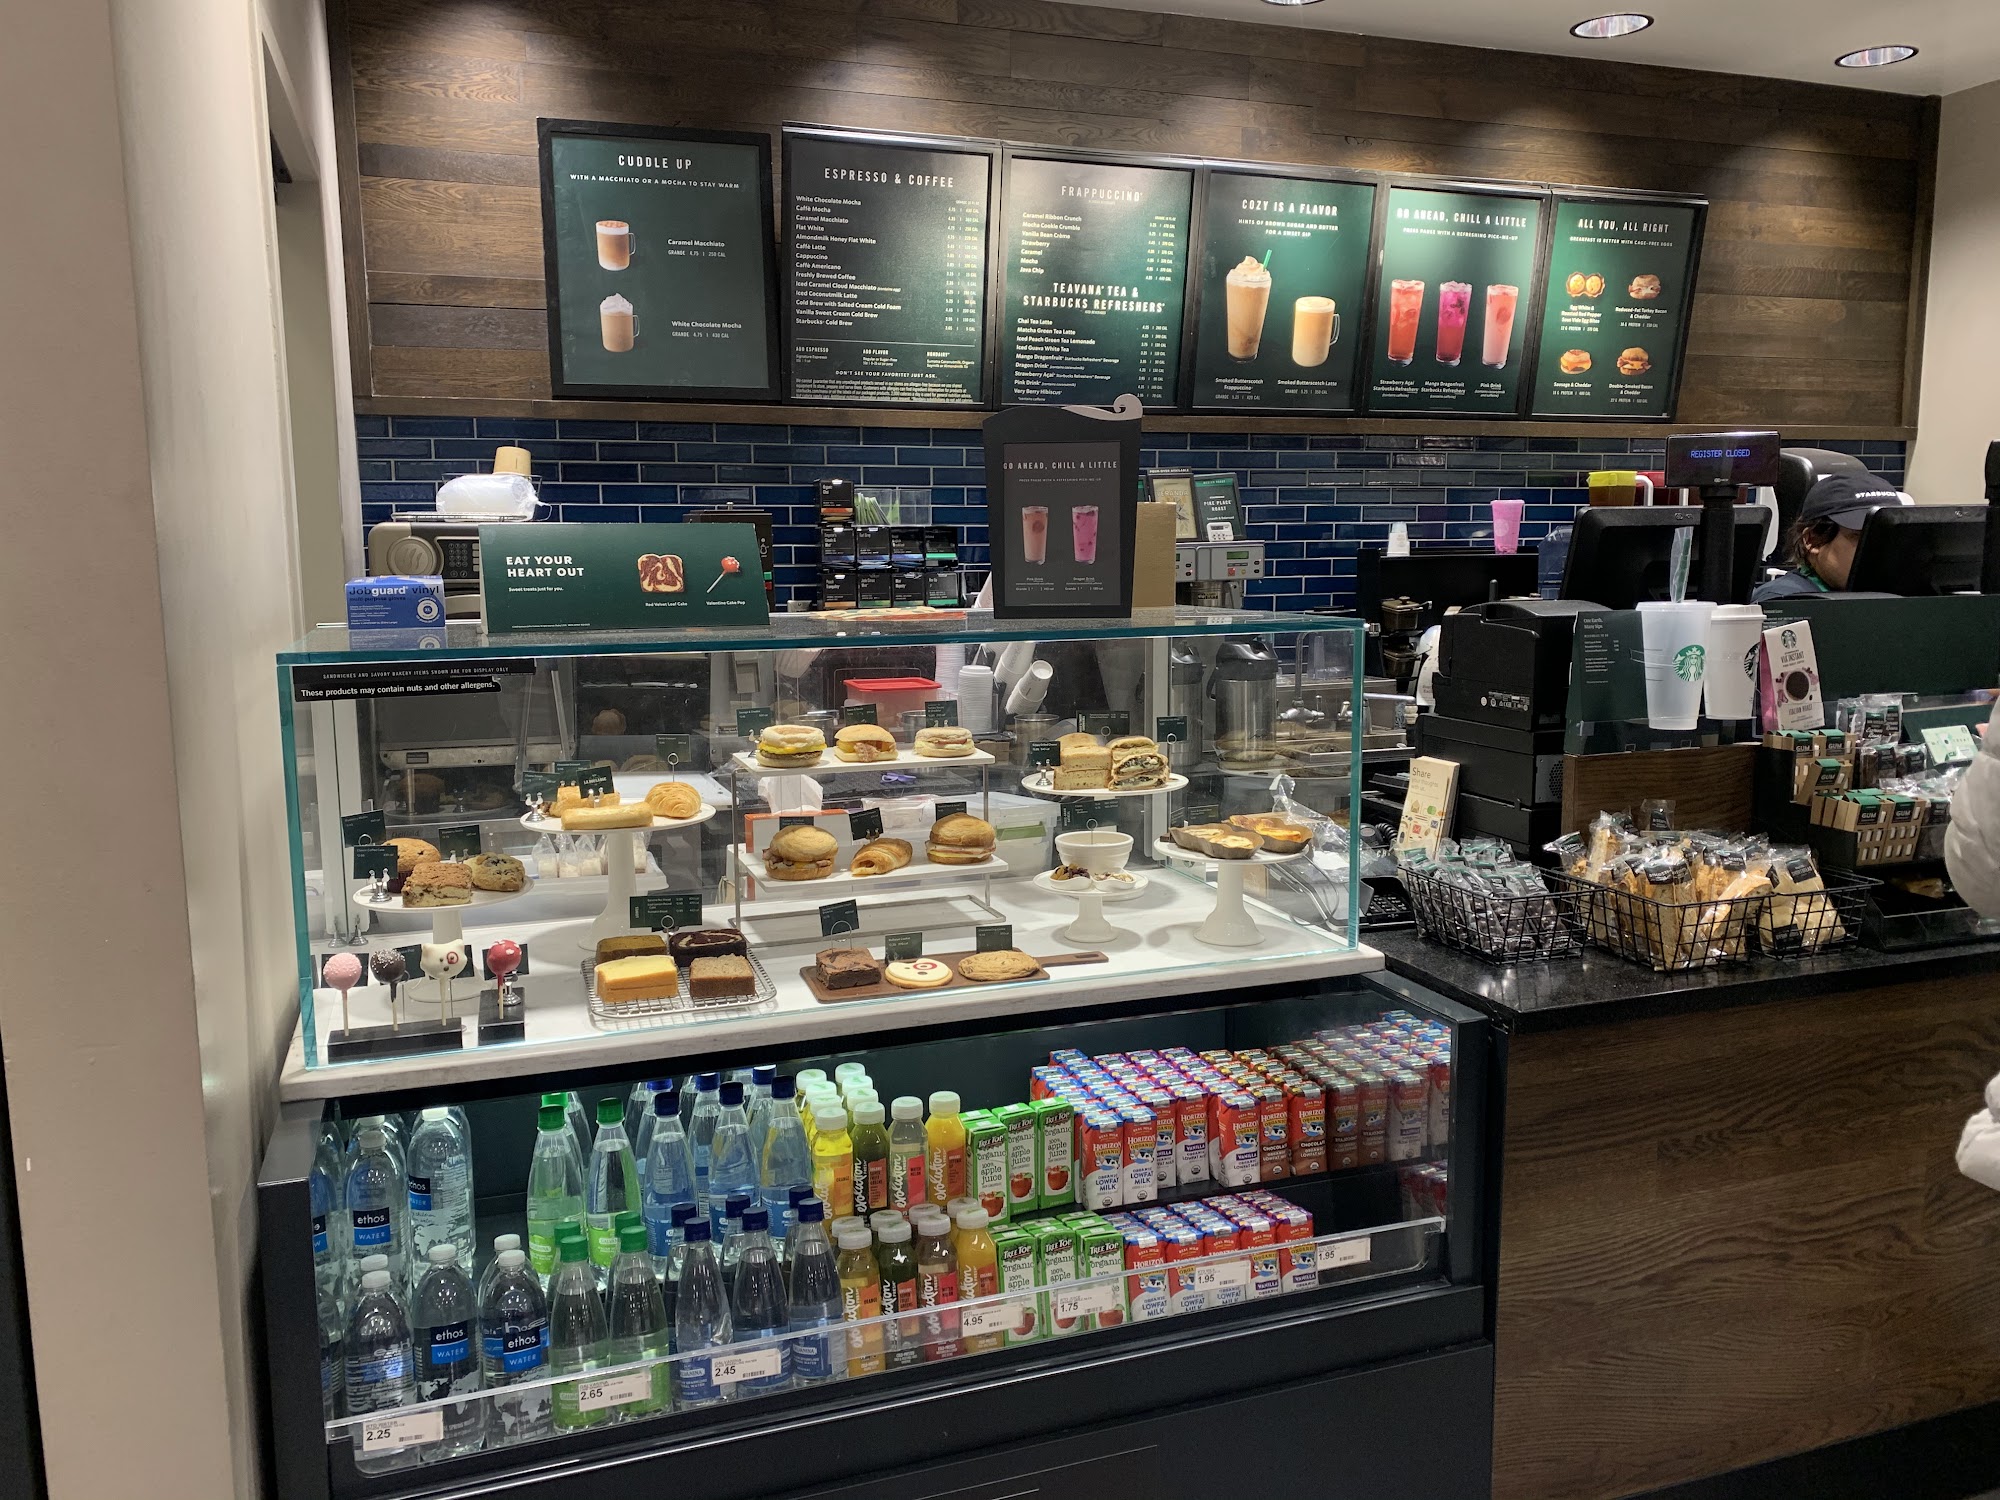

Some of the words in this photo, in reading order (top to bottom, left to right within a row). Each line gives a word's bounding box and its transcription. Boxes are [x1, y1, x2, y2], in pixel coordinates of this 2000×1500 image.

[618, 155, 668, 169] CUDDLE
[676, 159, 693, 169] UP
[825, 168, 887, 183] ESPRESSO
[894, 173, 901, 184] &
[909, 175, 954, 187] COFFEE
[1061, 185, 1140, 201] FRAPPUCCINO
[1242, 199, 1268, 211] COZY
[1274, 202, 1284, 212] IS
[1289, 203, 1294, 213] A
[1300, 204, 1337, 216] FLAVOR
[796, 214, 819, 222] Caramel
[820, 216, 848, 224] Macchiato
[1397, 208, 1409, 219] GO
[1414, 209, 1448, 223] AHEAD,
[1454, 212, 1480, 224] CHILL
[1485, 215, 1490, 224] A
[1496, 216, 1526, 227] LITTLE
[1578, 219, 1593, 229] ALL
[1599, 220, 1618, 231] YOU,
[1623, 222, 1638, 231] ALL
[1643, 223, 1669, 233] RIGHT
[796, 234, 829, 242] Almondmilk
[830, 236, 848, 244] Honey
[1022, 240, 1050, 248] Strawberry
[796, 271, 815, 279] Freshly
[838, 273, 856, 281] Coffee
[1107, 285, 1126, 297] TEA
[1132, 287, 1139, 298] &
[1023, 295, 1088, 308] STARBUCKS
[1691, 450, 1722, 458] REGISTER
[1726, 449, 1750, 457] CLOSED
[1089, 461, 1117, 469] LITTLE
[506, 556, 530, 565] EAT
[534, 556, 573, 565] YOUR
[507, 568, 551, 578] HEART
[556, 568, 584, 577] OUT
[349, 586, 406, 596] Jobguard
[412, 586, 439, 596] vinyl
[1789, 651, 1804, 661] INSTANT
[301, 689, 323, 697] These
[326, 688, 358, 697] products
[377, 685, 405, 693] contain
[460, 681, 495, 690] allergens.
[1412, 766, 1431, 778] Share
[1046, 1114, 1058, 1124] TREE
[1059, 1112, 1070, 1120] TOP
[1299, 1108, 1325, 1118] HORIZON
[1233, 1121, 1259, 1130] HORIZON
[1127, 1135, 1156, 1144] HORIZON
[1048, 1141, 1067, 1151] apple
[1093, 1142, 1122, 1151] HORIZON
[1011, 1148, 1031, 1158] apple
[1048, 1149, 1067, 1159] juice
[1011, 1156, 1030, 1167] juice
[929, 1147, 946, 1200] evolution
[981, 1165, 1002, 1175] apple
[1130, 1171, 1153, 1179] LOWFAT
[854, 1158, 867, 1213] evolution
[892, 1154, 906, 1209] evolution
[1100, 1184, 1116, 1192] MILK
[357, 1213, 385, 1225] ethos
[358, 1231, 385, 1239] WATER
[1004, 1250, 1018, 1259] TREE
[1018, 1246, 1031, 1254] TOP
[1090, 1247, 1104, 1255] TREE
[1133, 1258, 1164, 1269] HORIZON
[1050, 1271, 1071, 1282] apple
[1198, 1275, 1214, 1284] 1.95
[1008, 1278, 1030, 1289] apple
[1060, 1302, 1078, 1312] 1.75
[1142, 1301, 1167, 1311] LOWFAT
[1181, 1298, 1205, 1307] LOWFAT
[1147, 1308, 1164, 1317] MILK
[963, 1316, 983, 1326] 4.95
[435, 1328, 464, 1341] ethos
[507, 1334, 536, 1349] ethos
[437, 1348, 464, 1358] WATER
[509, 1354, 537, 1365] WATER
[715, 1366, 736, 1377] 2.45
[580, 1388, 603, 1401] 2.65
[366, 1428, 391, 1441] 2.25
